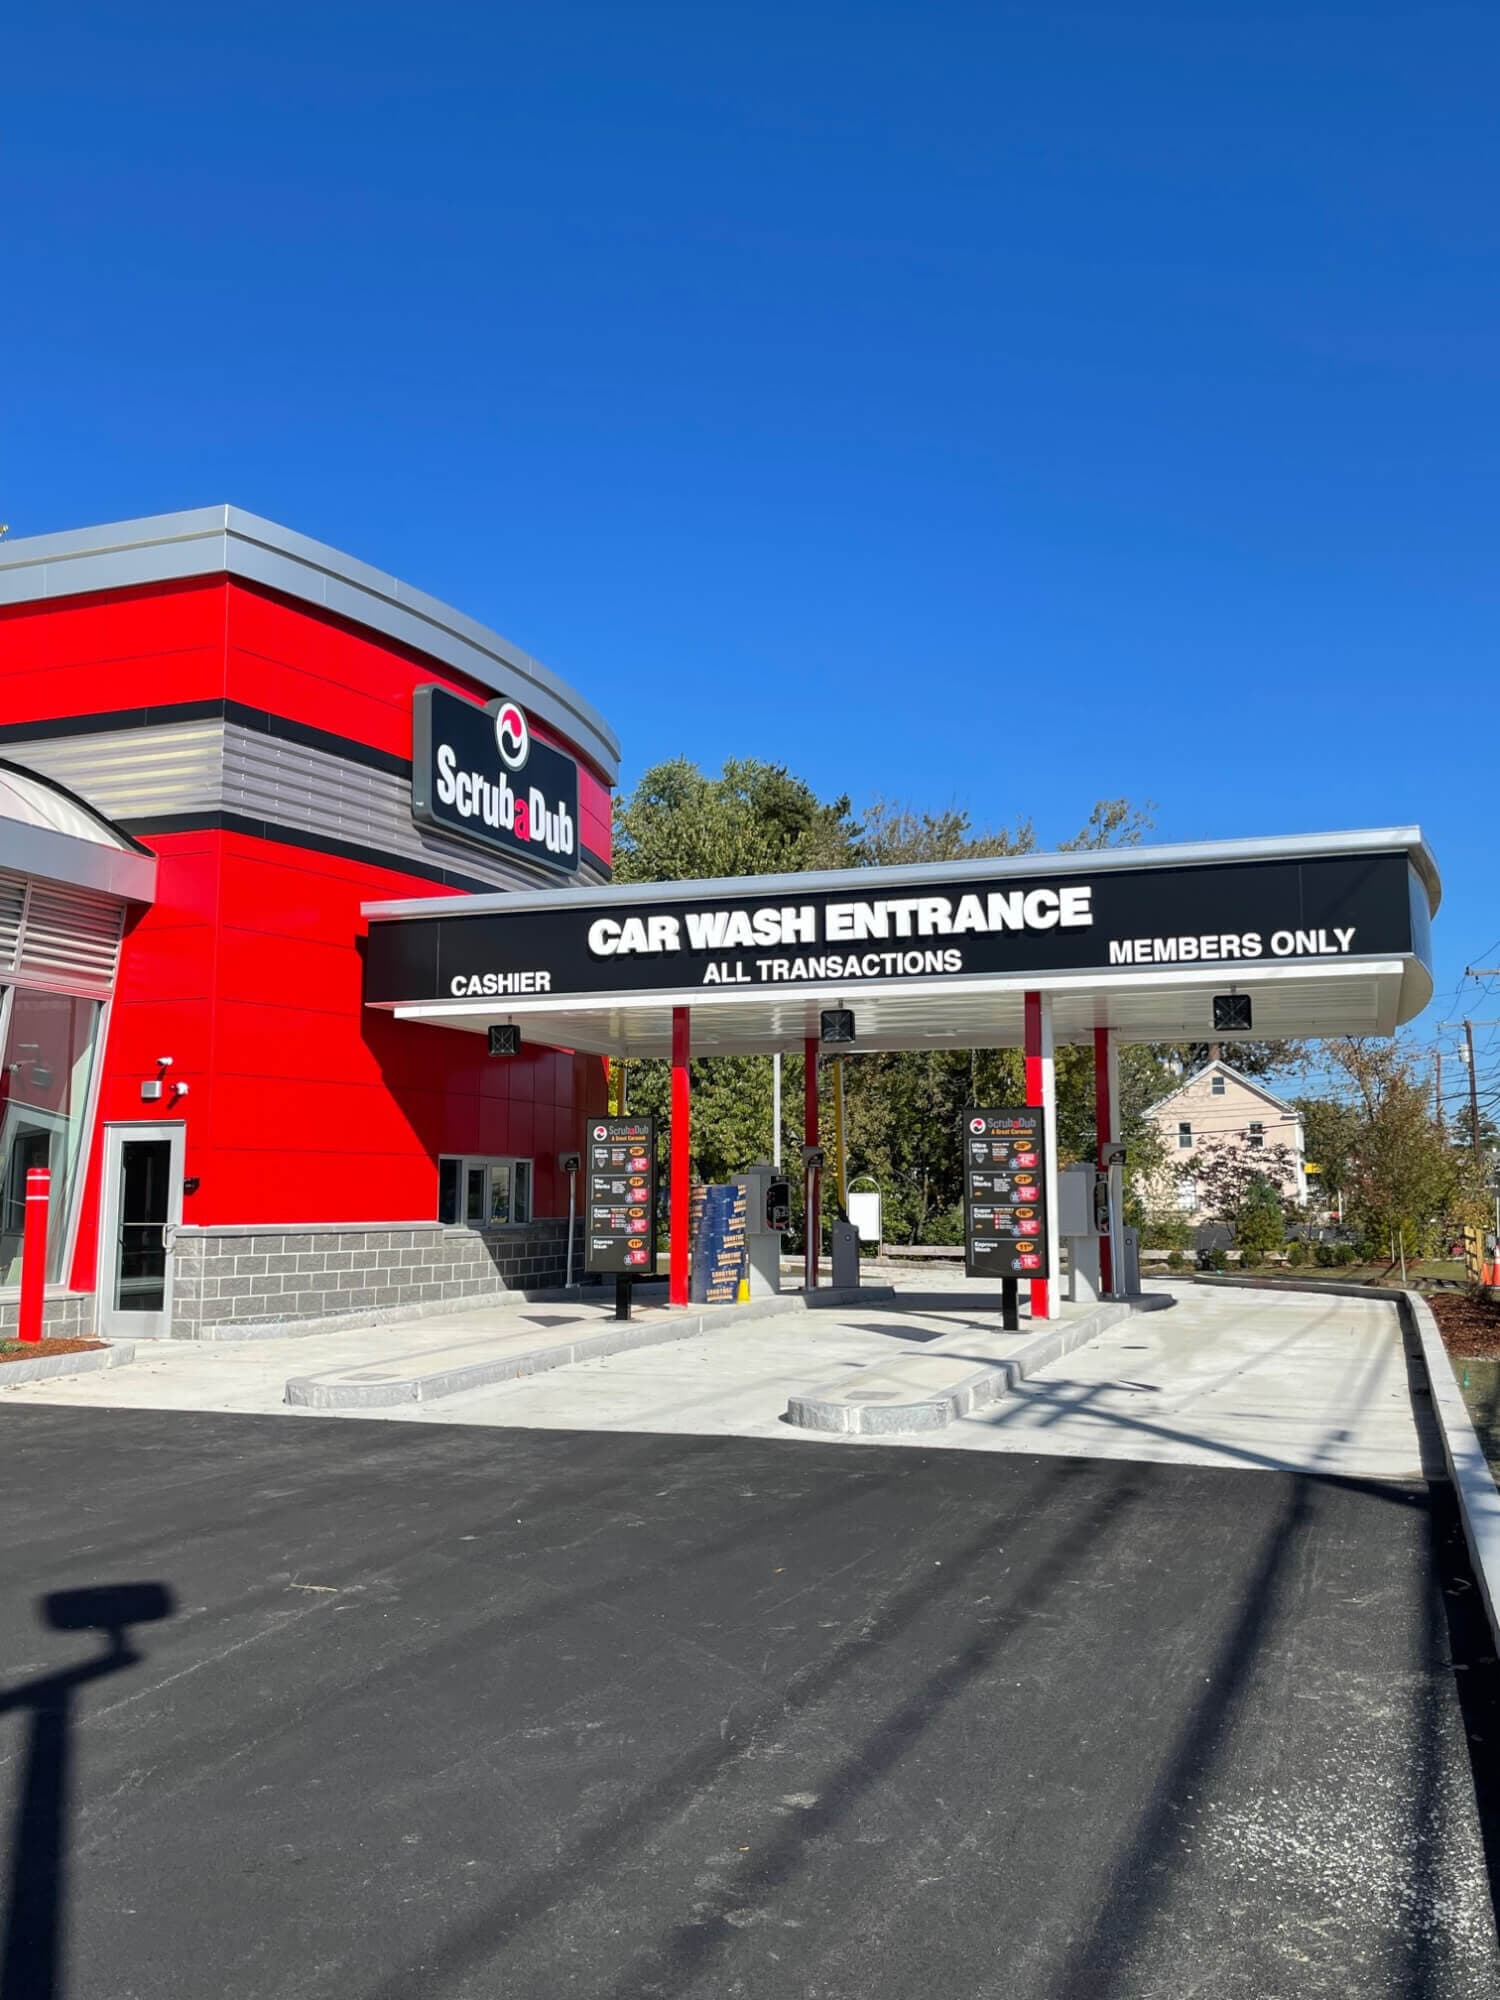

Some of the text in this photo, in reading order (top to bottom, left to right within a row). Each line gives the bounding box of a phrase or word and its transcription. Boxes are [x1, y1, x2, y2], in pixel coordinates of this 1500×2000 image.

[437, 744, 574, 855] ScrubaDub
[588, 886, 1093, 956] CAR WASH ENTRANCE
[1108, 927, 1356, 965] MEMBERS ONLY
[450, 970, 552, 997] CASHIER
[703, 949, 963, 985] ALL TRANSACTIONS
